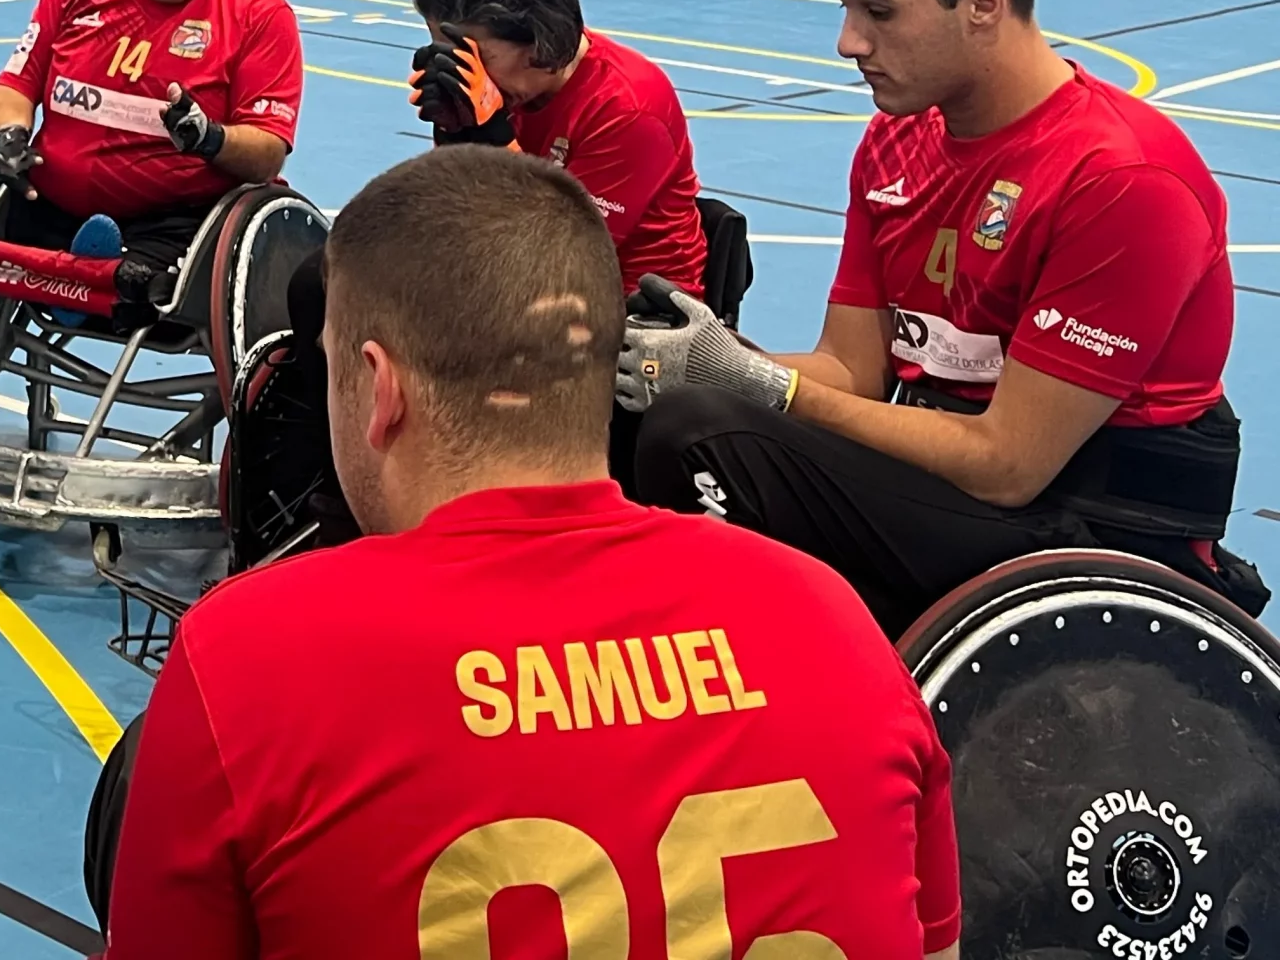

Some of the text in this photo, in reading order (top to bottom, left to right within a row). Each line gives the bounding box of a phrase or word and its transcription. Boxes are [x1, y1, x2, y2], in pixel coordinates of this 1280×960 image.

[107, 36, 151, 83] 14
[924, 228, 958, 297] 4
[1060, 327, 1114, 357] Unicaja
[1065, 317, 1138, 352] Fundación
[455, 628, 768, 737] SAMUEL
[1066, 789, 1208, 912] ORTOPEDIA.COM
[1097, 892, 1213, 960] 954234523
